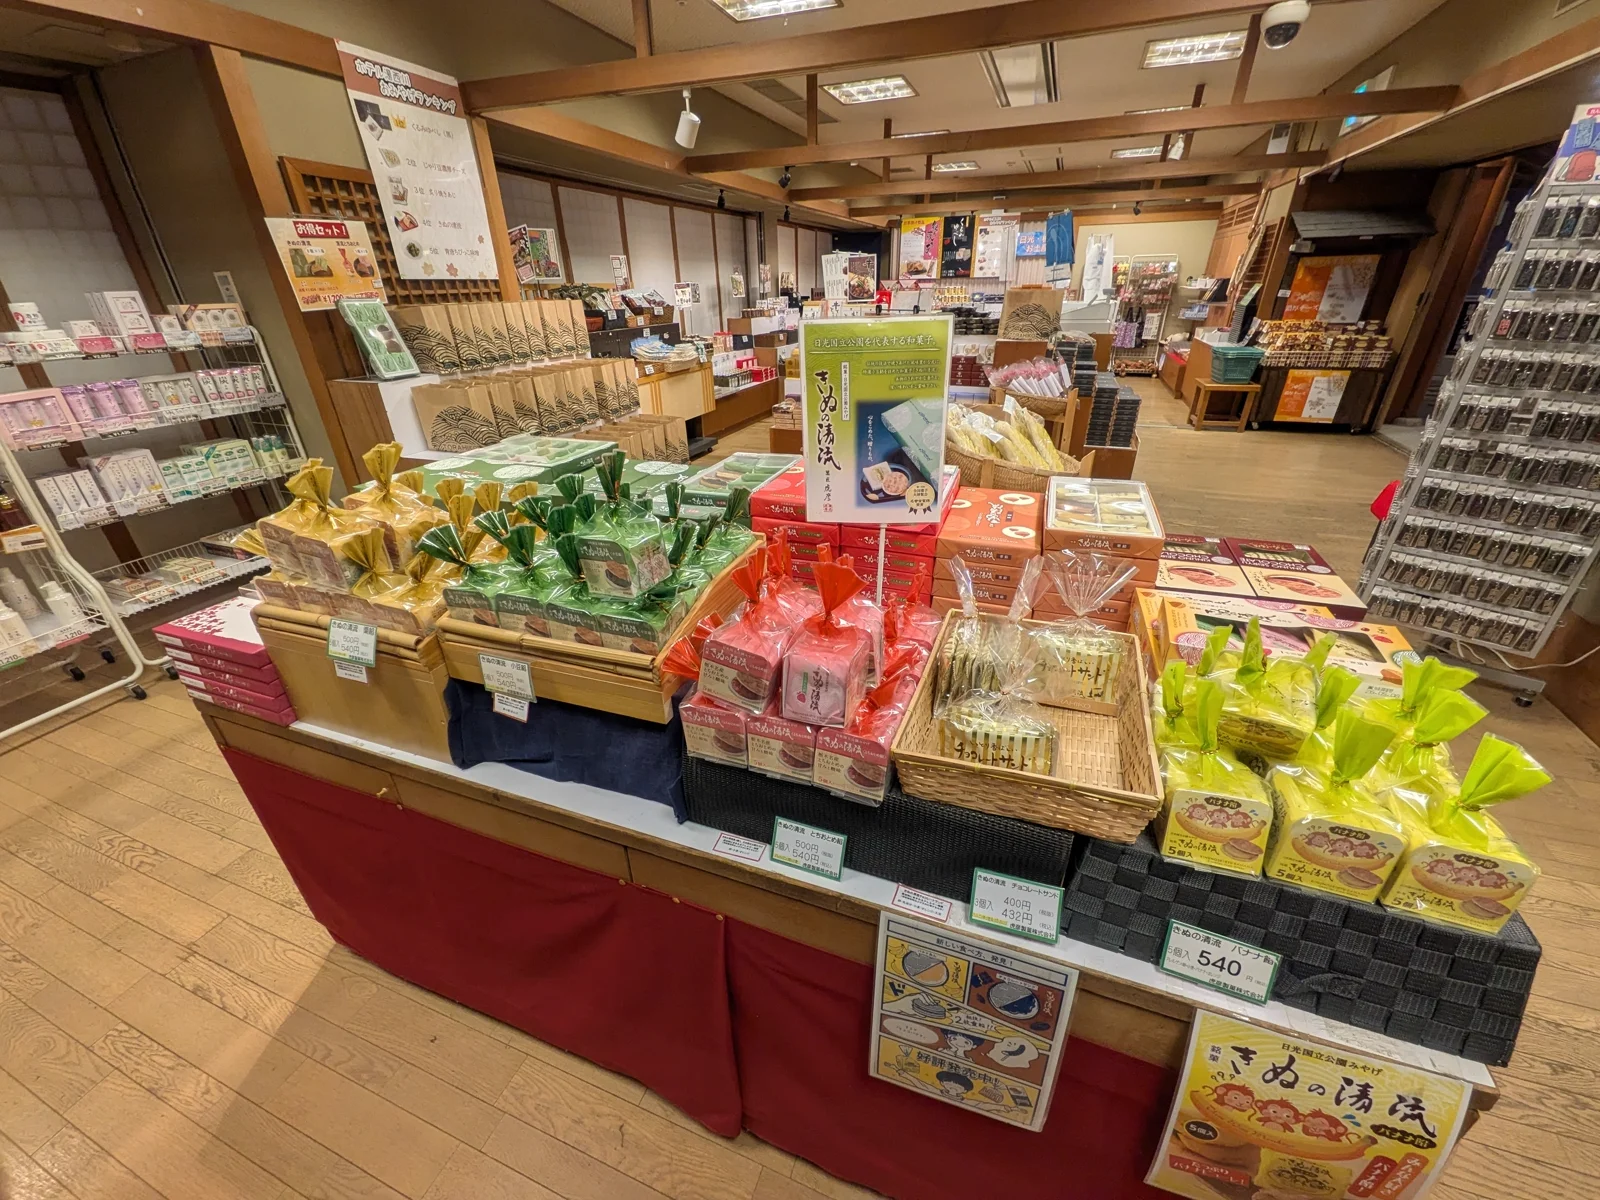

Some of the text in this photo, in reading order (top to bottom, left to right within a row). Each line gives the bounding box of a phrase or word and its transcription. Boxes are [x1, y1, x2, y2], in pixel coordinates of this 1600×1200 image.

[379, 79, 457, 116] おみやげランキング
[296, 223, 347, 236] お得セット！
[814, 335, 937, 348] 日光国立公園を代表する和菓子。
[814, 371, 841, 471] きぬの清流
[1078, 538, 1111, 551] きぬの清流
[332, 621, 358, 632] きぬの清流
[481, 656, 506, 667] きぬの清流
[710, 648, 750, 672] きぬの清流
[754, 721, 794, 741] きぬの清流
[824, 736, 865, 759] きぬの清流
[1209, 798, 1238, 808] バナナ餡
[777, 821, 843, 845] きぬの清流 とちおとめ餡
[1334, 827, 1366, 840] バナナ餡
[775, 841, 791, 853] 5個入
[795, 839, 819, 854] 500円
[1168, 846, 1193, 859] 5個入
[1178, 838, 1219, 856] きぬの清流
[793, 849, 820, 865] 540円
[1460, 855, 1495, 869] バナナ餡
[1276, 869, 1303, 883] 5個入
[1289, 862, 1333, 882] きぬの清流
[977, 875, 1059, 899] きぬの清流 チョコレートサンド
[975, 898, 994, 912] 3個入
[1004, 896, 1032, 912] 400円
[1002, 909, 1033, 926] 432円
[936, 937, 1014, 967] 新しい食べ方、発見！
[1173, 925, 1275, 966] きぬの清流 バナナ餡
[1168, 945, 1191, 961] 5個入
[1197, 950, 1242, 977] 540
[1246, 975, 1254, 983] 円
[1281, 1042, 1383, 1077] 日光国立公園みやげ
[1231, 1045, 1438, 1139] きぬの清流
[1189, 1124, 1215, 1139] 5個入
[1378, 1128, 1429, 1148] バナナ餡
